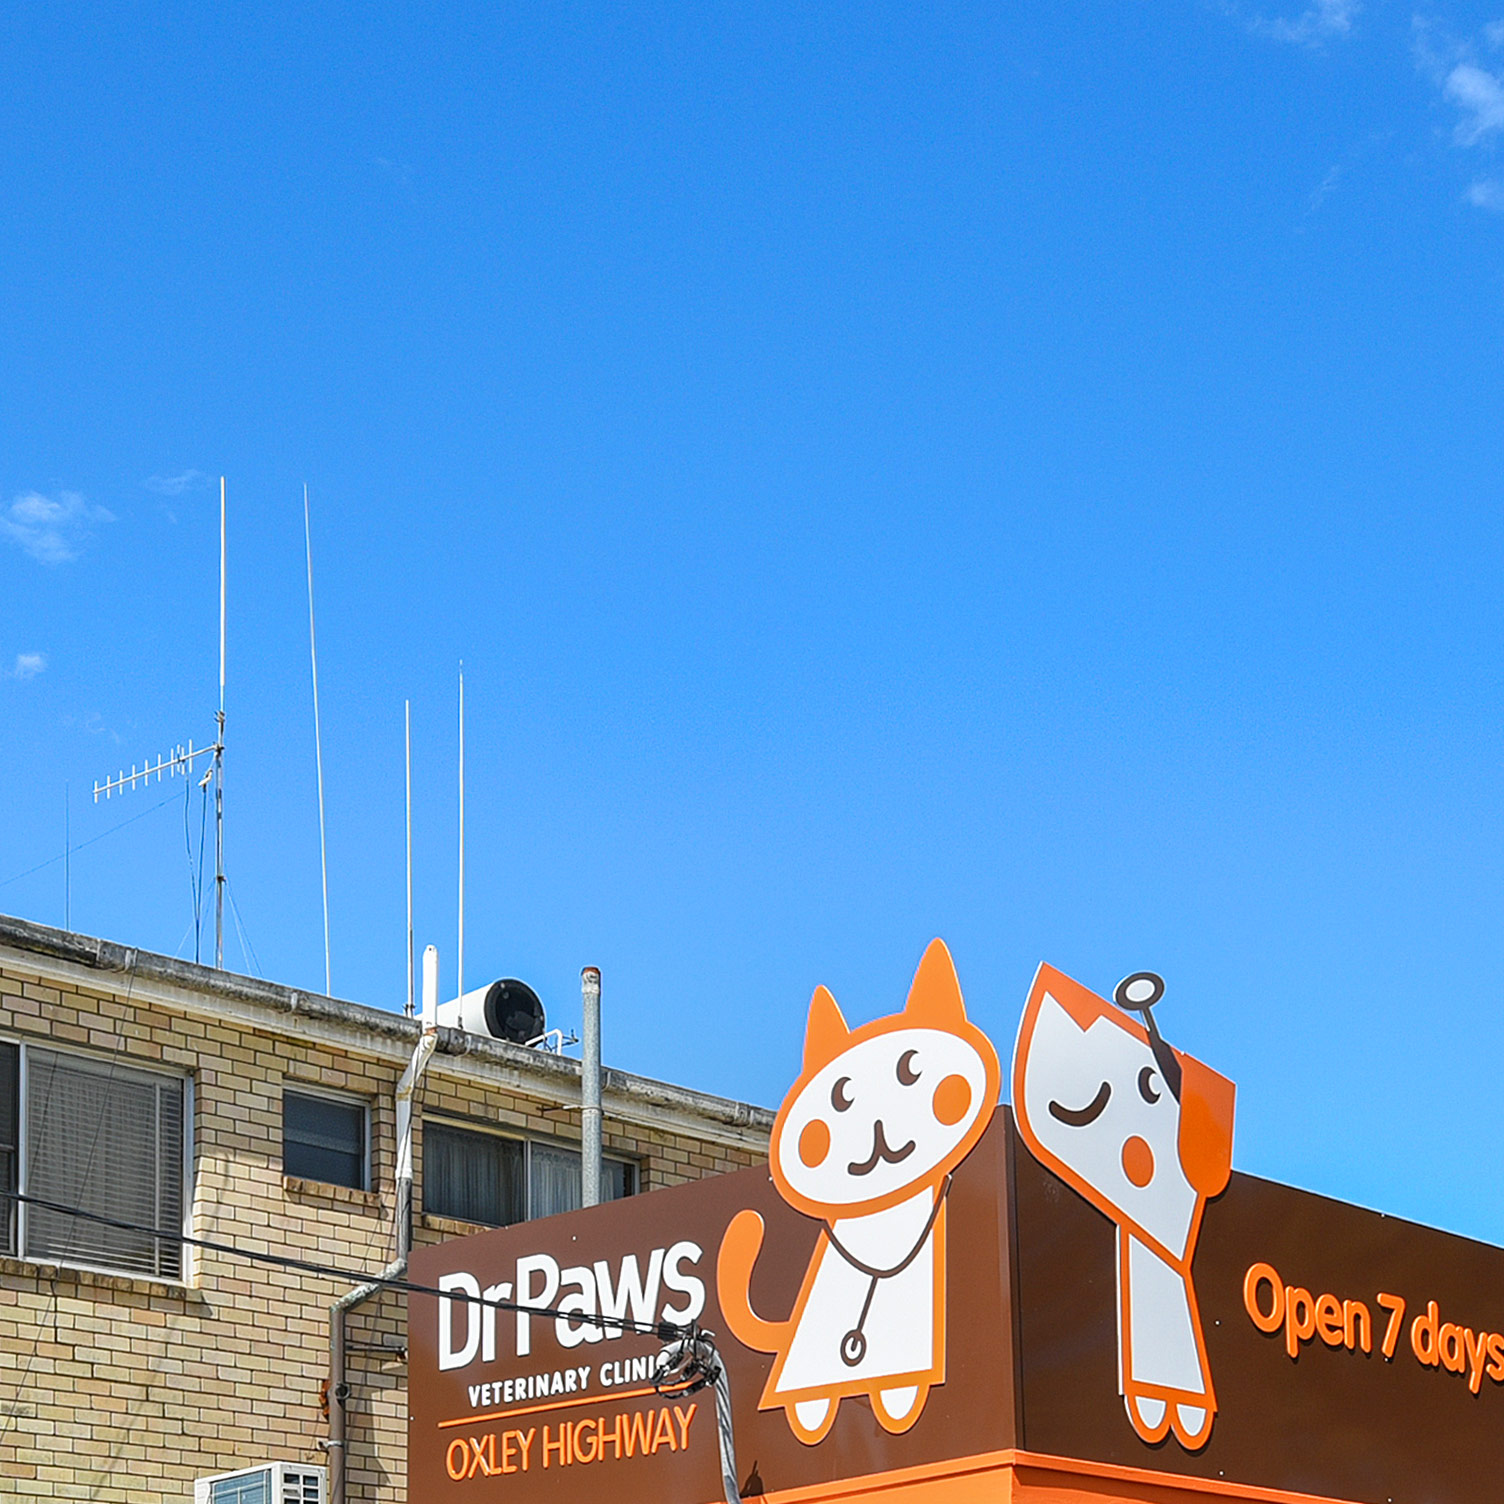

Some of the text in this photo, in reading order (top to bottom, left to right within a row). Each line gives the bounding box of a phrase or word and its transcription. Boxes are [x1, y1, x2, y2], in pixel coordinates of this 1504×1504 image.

[1244, 1262, 1371, 1359] Open
[1377, 1292, 1406, 1358] 7
[468, 1366, 591, 1408] VETERINARY
[446, 1403, 697, 1481] OXLEY HIGHWAY
